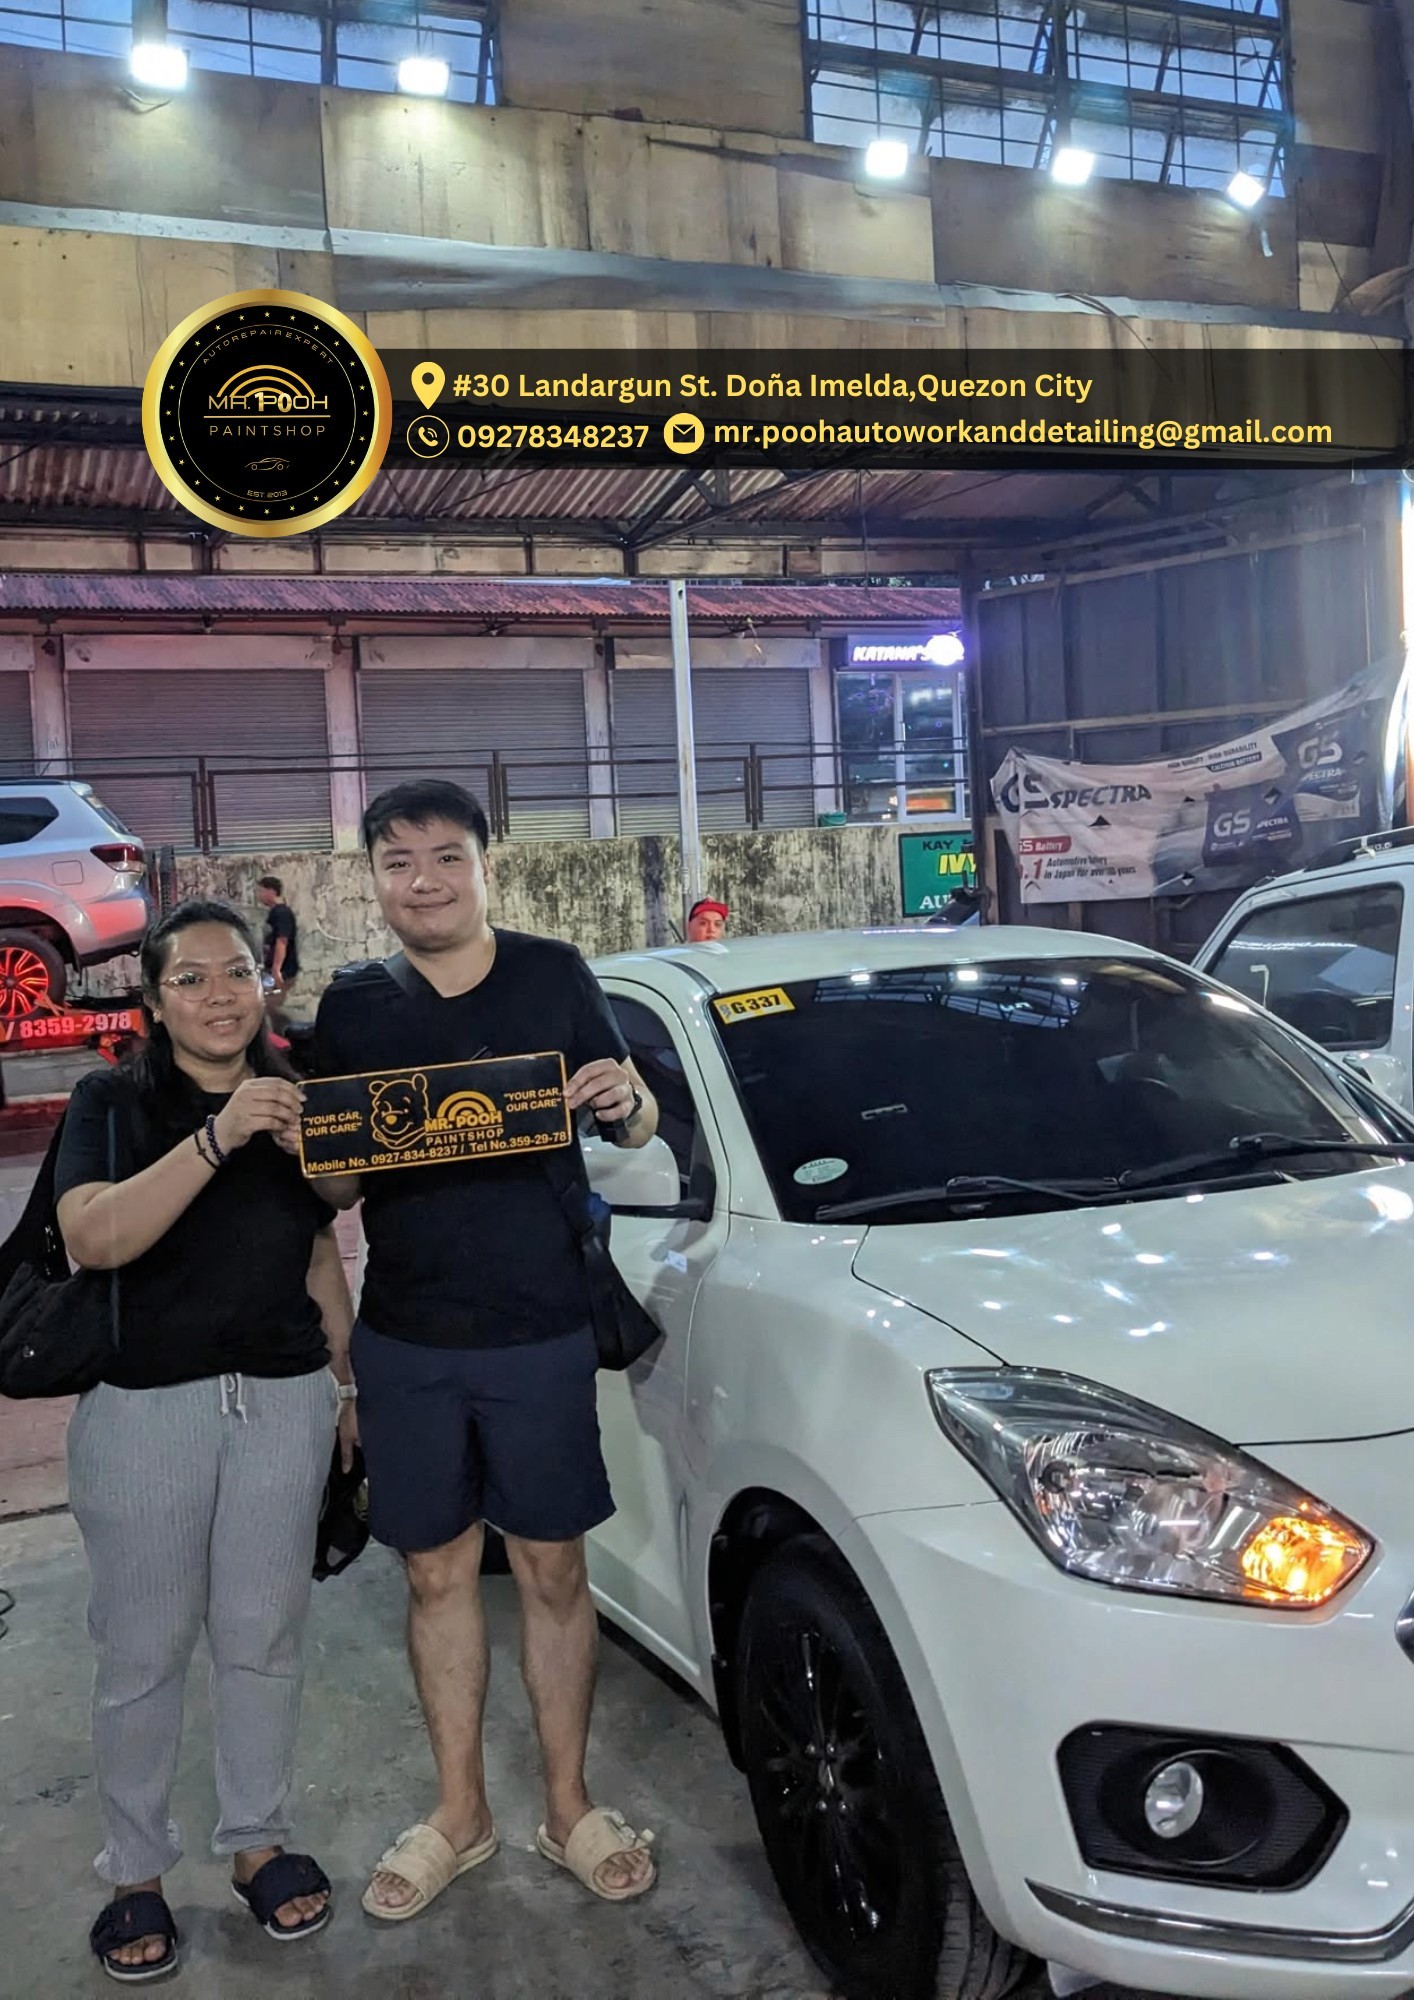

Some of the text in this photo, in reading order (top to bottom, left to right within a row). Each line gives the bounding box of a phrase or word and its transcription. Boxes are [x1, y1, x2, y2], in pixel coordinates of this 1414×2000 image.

[1050, 784, 1152, 808] SPECTRA
[1213, 808, 1251, 837] GS
[922, 840, 953, 851] KAY
[20, 1012, 131, 1038] 8359-2978
[503, 1089, 537, 1101] "YOUR
[506, 1098, 562, 1113] OUR CARE"
[303, 1114, 337, 1126] "YOUR
[424, 1110, 503, 1132] MR. POOH
[305, 1122, 362, 1137] OUR CARE"
[426, 1128, 504, 1146] PAINTSHOP
[307, 1158, 346, 1173] Mobile
[349, 1154, 369, 1168] No.
[470, 1139, 488, 1153] Tel
